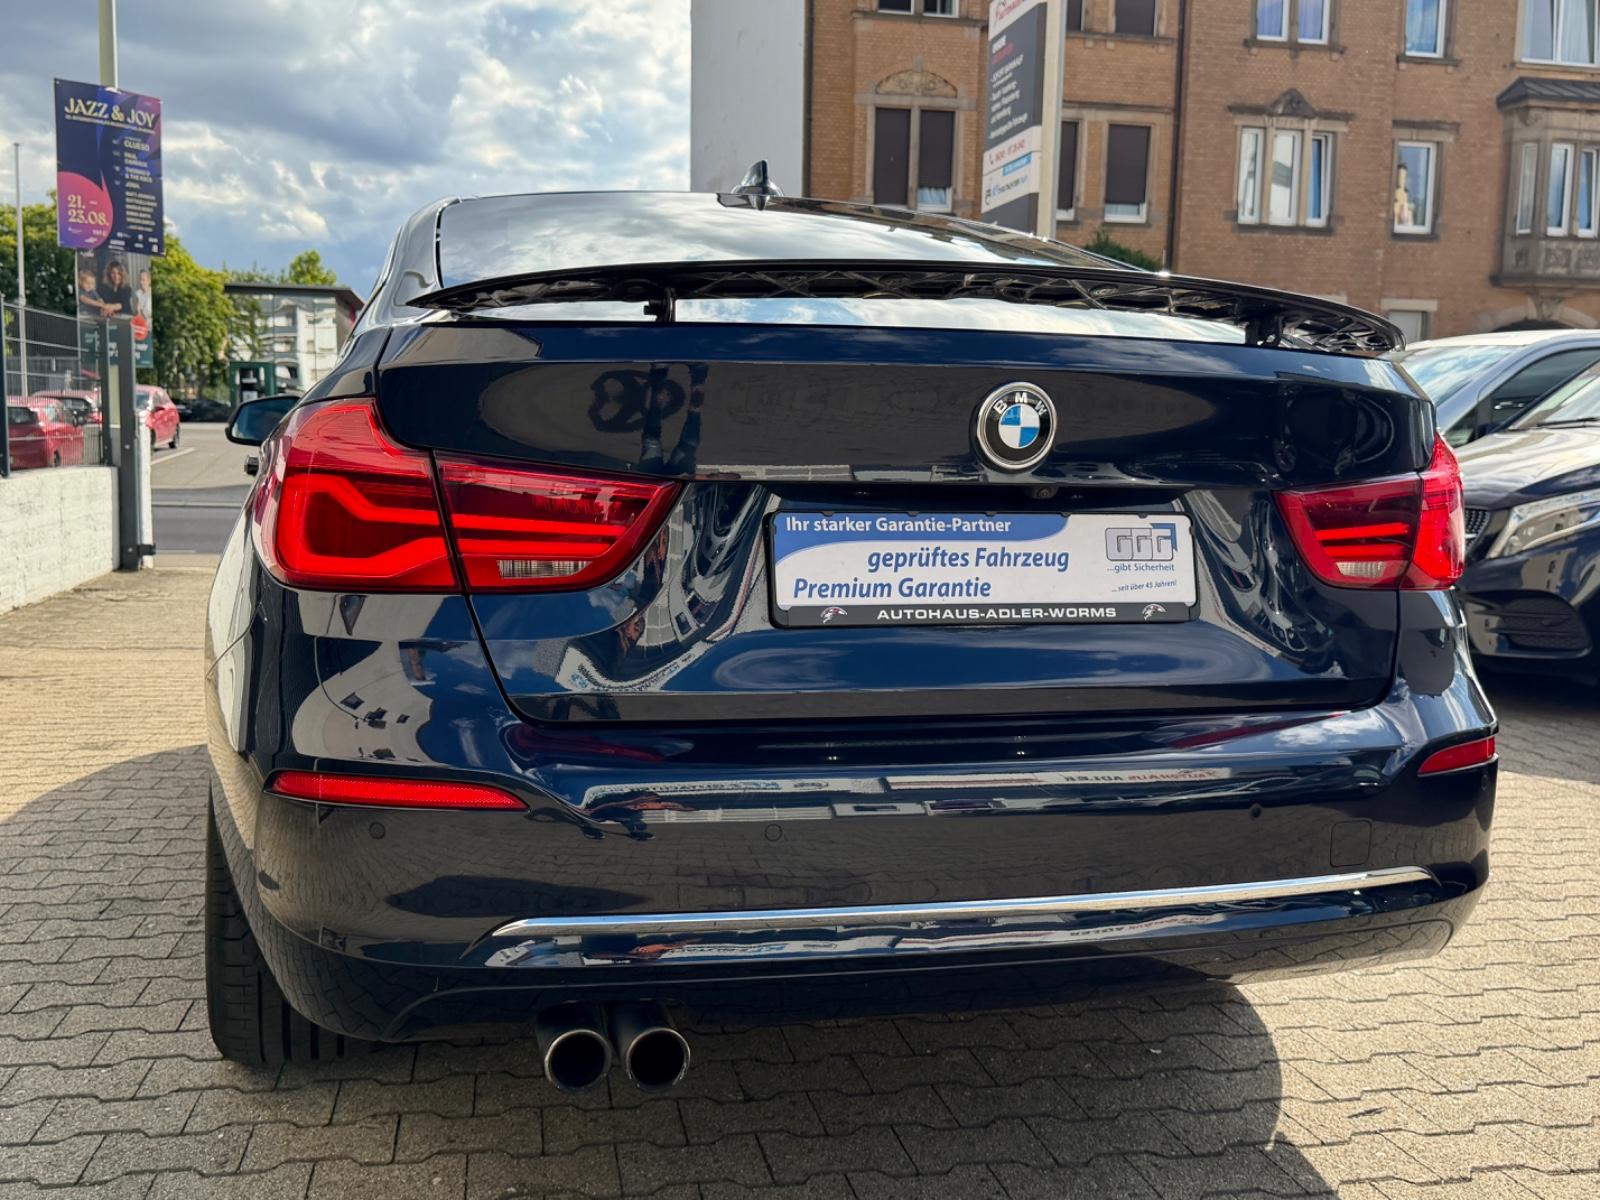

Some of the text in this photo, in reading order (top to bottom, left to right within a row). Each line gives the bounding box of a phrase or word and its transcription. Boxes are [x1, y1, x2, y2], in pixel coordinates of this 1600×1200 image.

[64, 98, 109, 119] JAZZ
[111, 104, 125, 122] &
[127, 109, 155, 128] JOY
[67, 194, 85, 208] 21.
[68, 209, 110, 226] 23.08.
[993, 392, 1047, 416] BMW
[786, 516, 1012, 532] Ihr starker Garantie-Partner
[868, 547, 1069, 573] geprüftes Fahrzeug
[1134, 563, 1175, 571] Sicherheit
[793, 577, 992, 598] Premium Garantie
[1130, 583, 1144, 591] über
[877, 607, 1117, 620] AUTOHAUS-ADLER-WORMS
